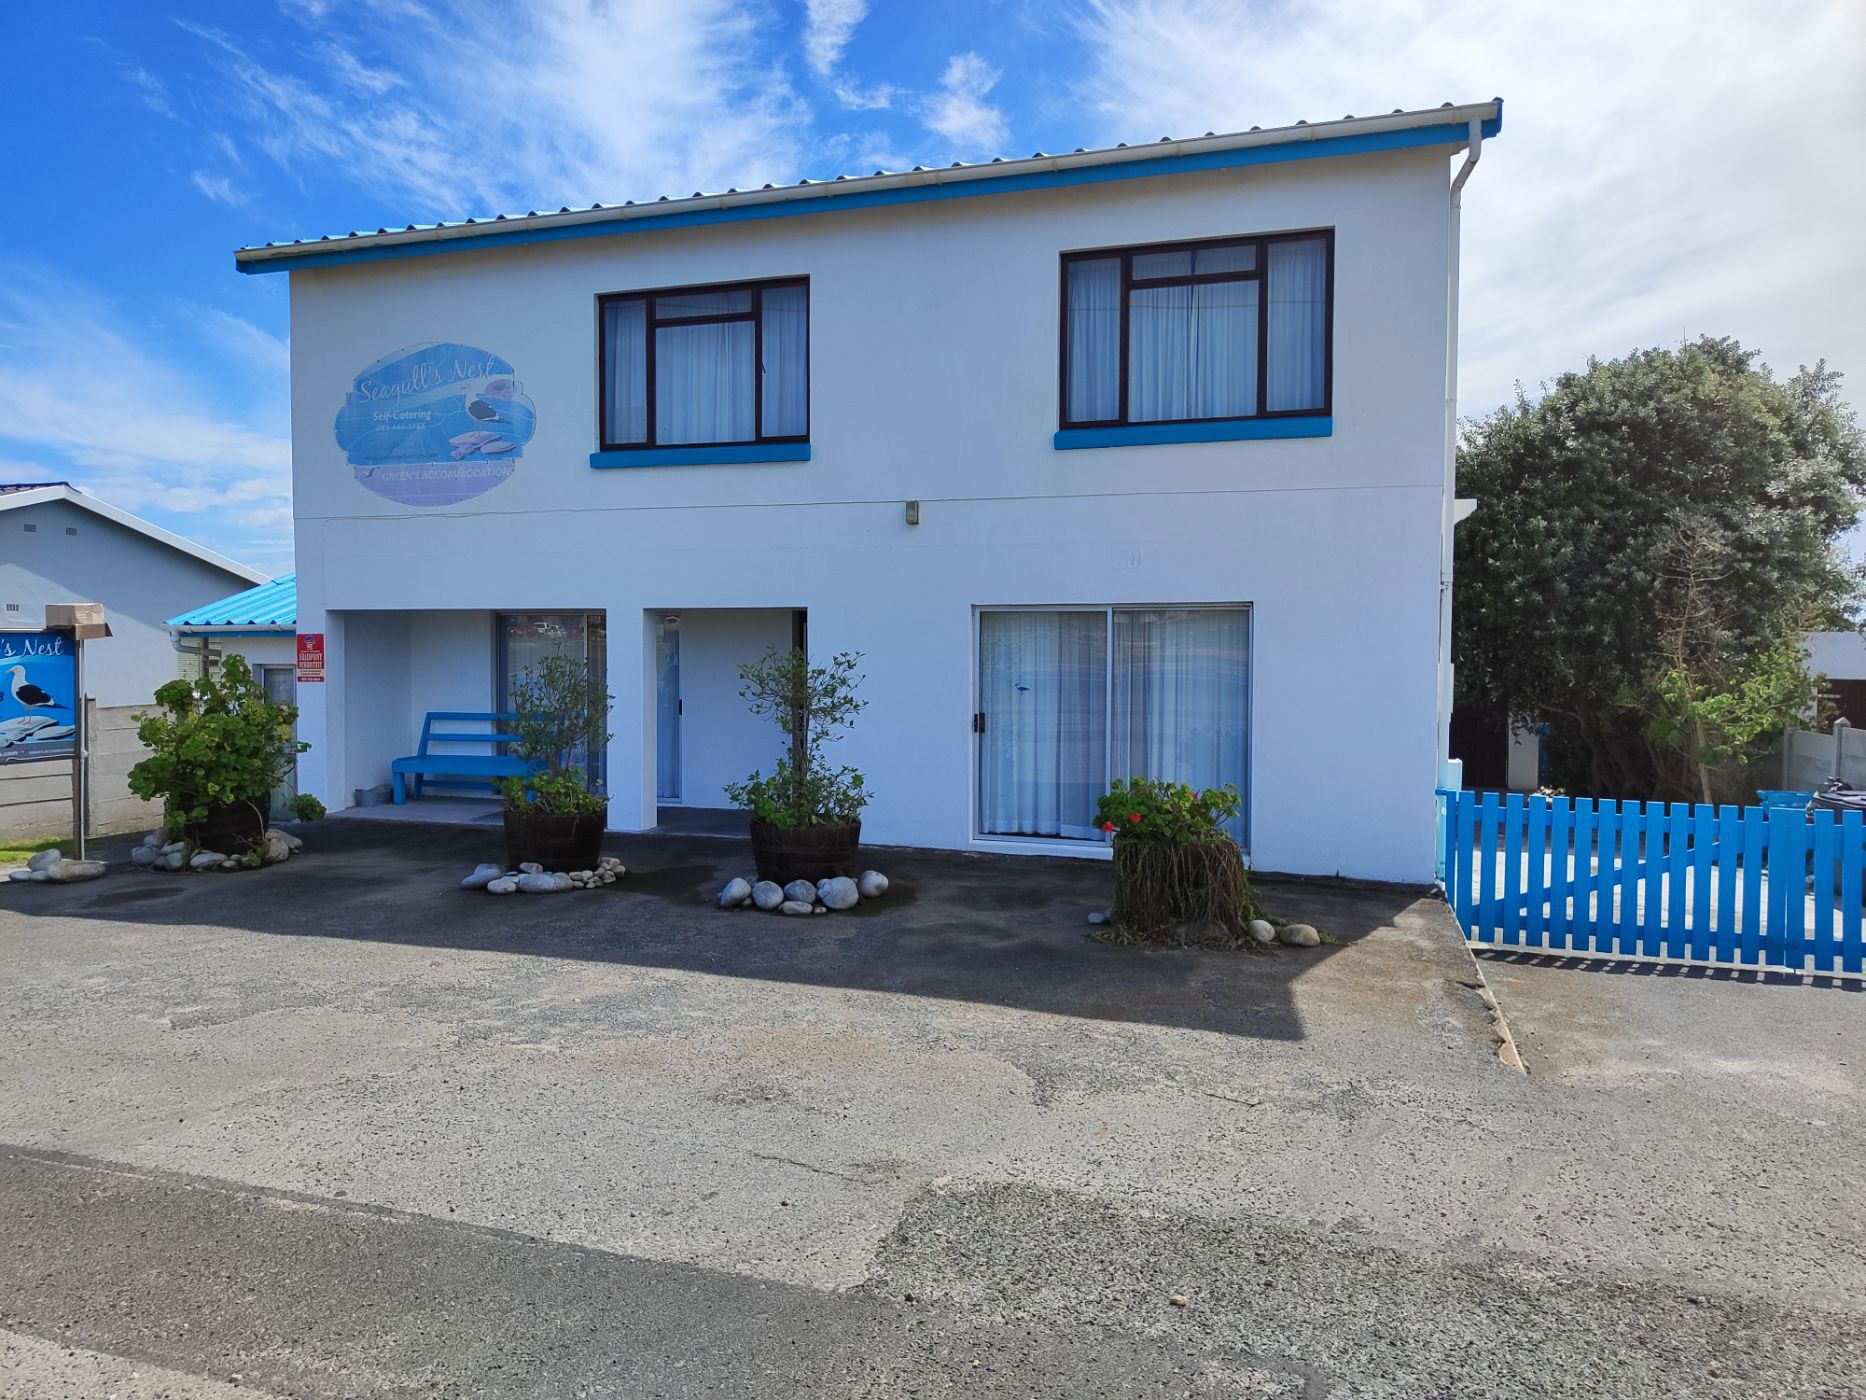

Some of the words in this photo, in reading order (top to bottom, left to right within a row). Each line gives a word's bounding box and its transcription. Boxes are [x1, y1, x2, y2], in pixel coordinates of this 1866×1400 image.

[359, 362, 444, 406] Seagull's
[448, 352, 495, 382] Nest
[372, 408, 432, 423] Self-Catering
[382, 470, 420, 482] GREEN'S
[422, 466, 511, 481] ACCOMMODATION
[18, 636, 63, 658] Nest
